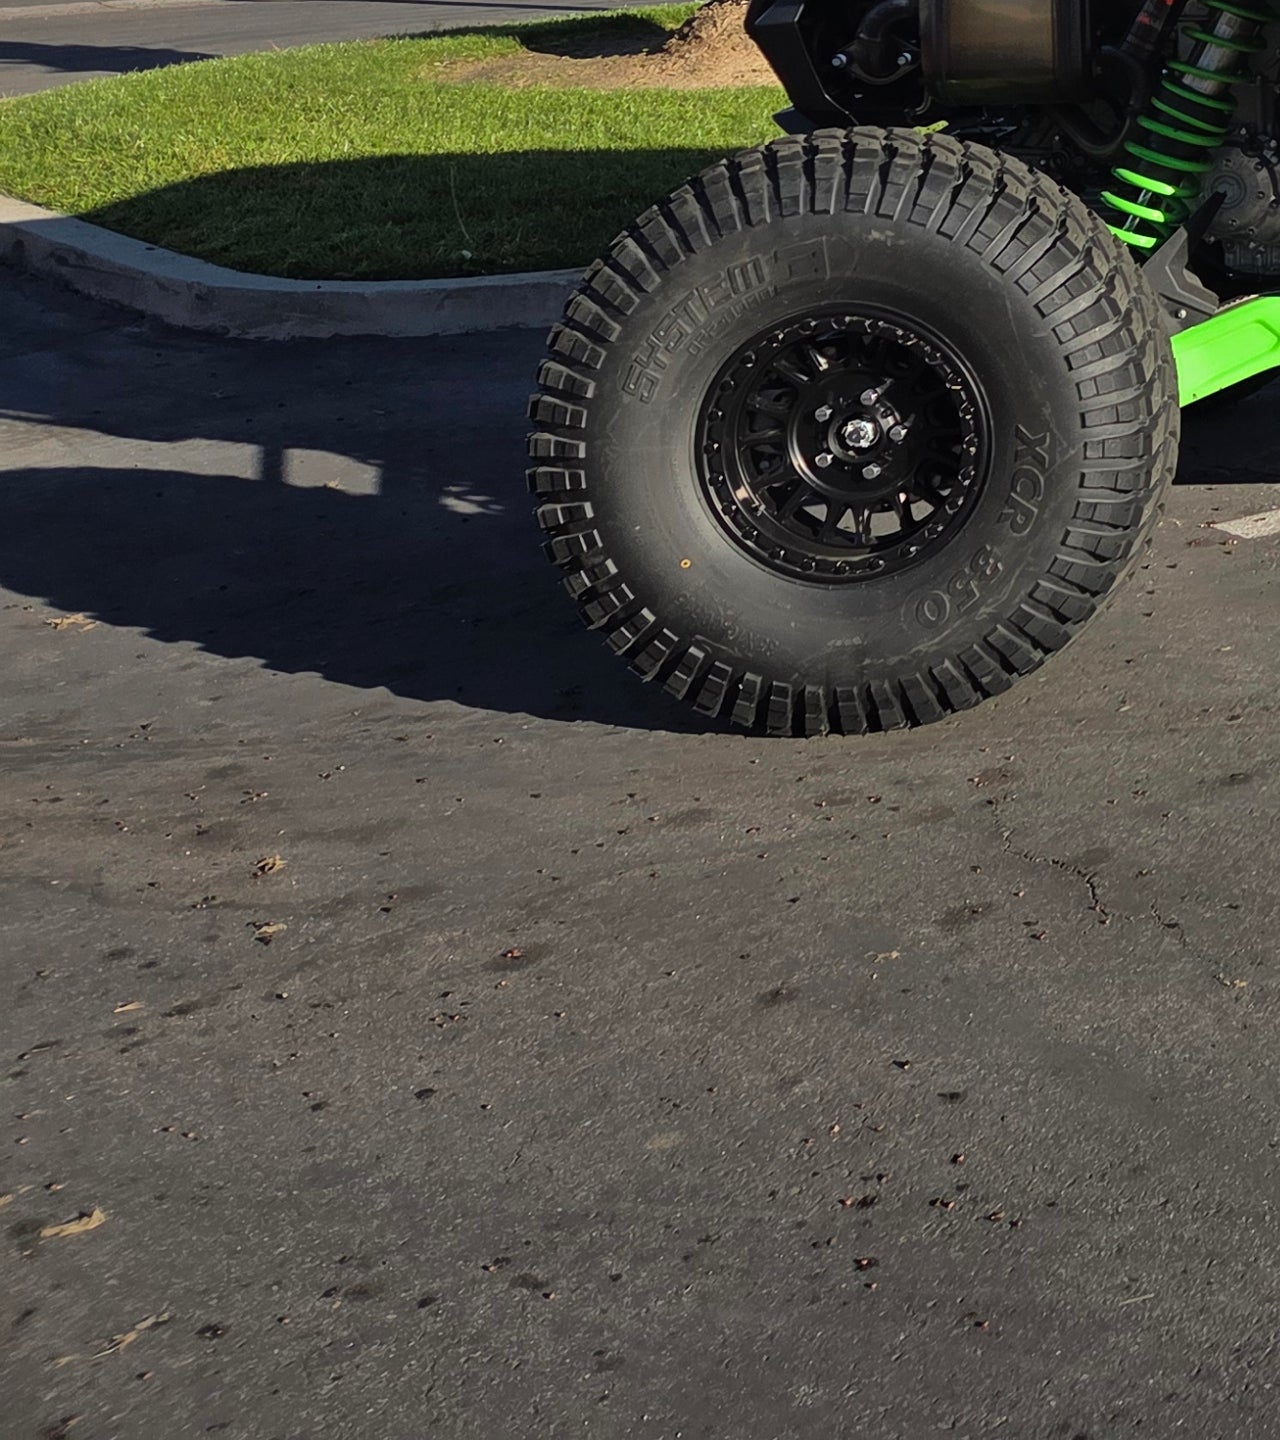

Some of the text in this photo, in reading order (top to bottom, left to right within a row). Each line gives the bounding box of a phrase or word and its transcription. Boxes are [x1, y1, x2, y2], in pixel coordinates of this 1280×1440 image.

[621, 255, 769, 404] SYSTEM
[914, 423, 1051, 630] XCR 350
